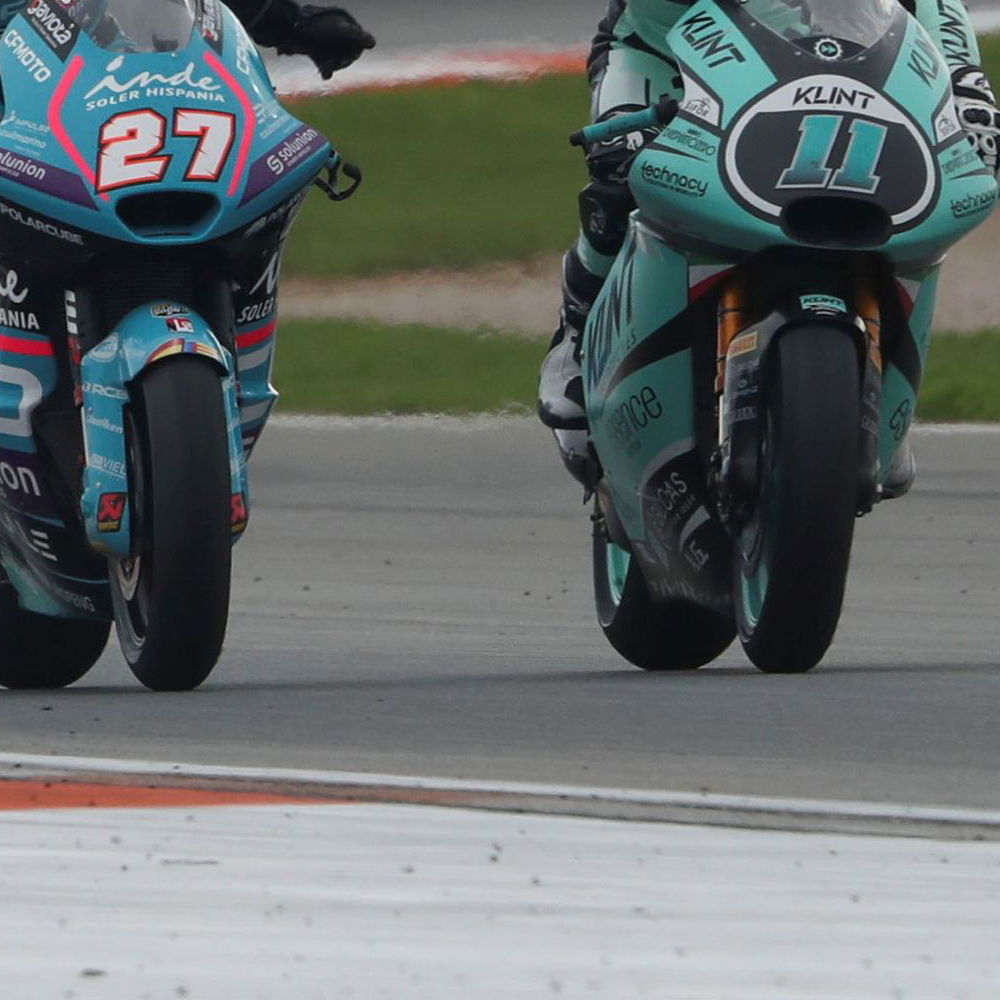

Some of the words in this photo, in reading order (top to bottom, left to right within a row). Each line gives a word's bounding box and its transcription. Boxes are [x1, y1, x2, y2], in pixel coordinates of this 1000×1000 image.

[3, 29, 53, 83] CFMOTO
[677, 10, 746, 68] KLINT
[85, 90, 140, 112] SOLER
[146, 87, 225, 103] HISPANIA
[793, 85, 876, 109] KLINT
[95, 107, 237, 195] 27
[279, 127, 318, 163] solunion
[775, 114, 888, 194] 11
[641, 160, 708, 197] technacy
